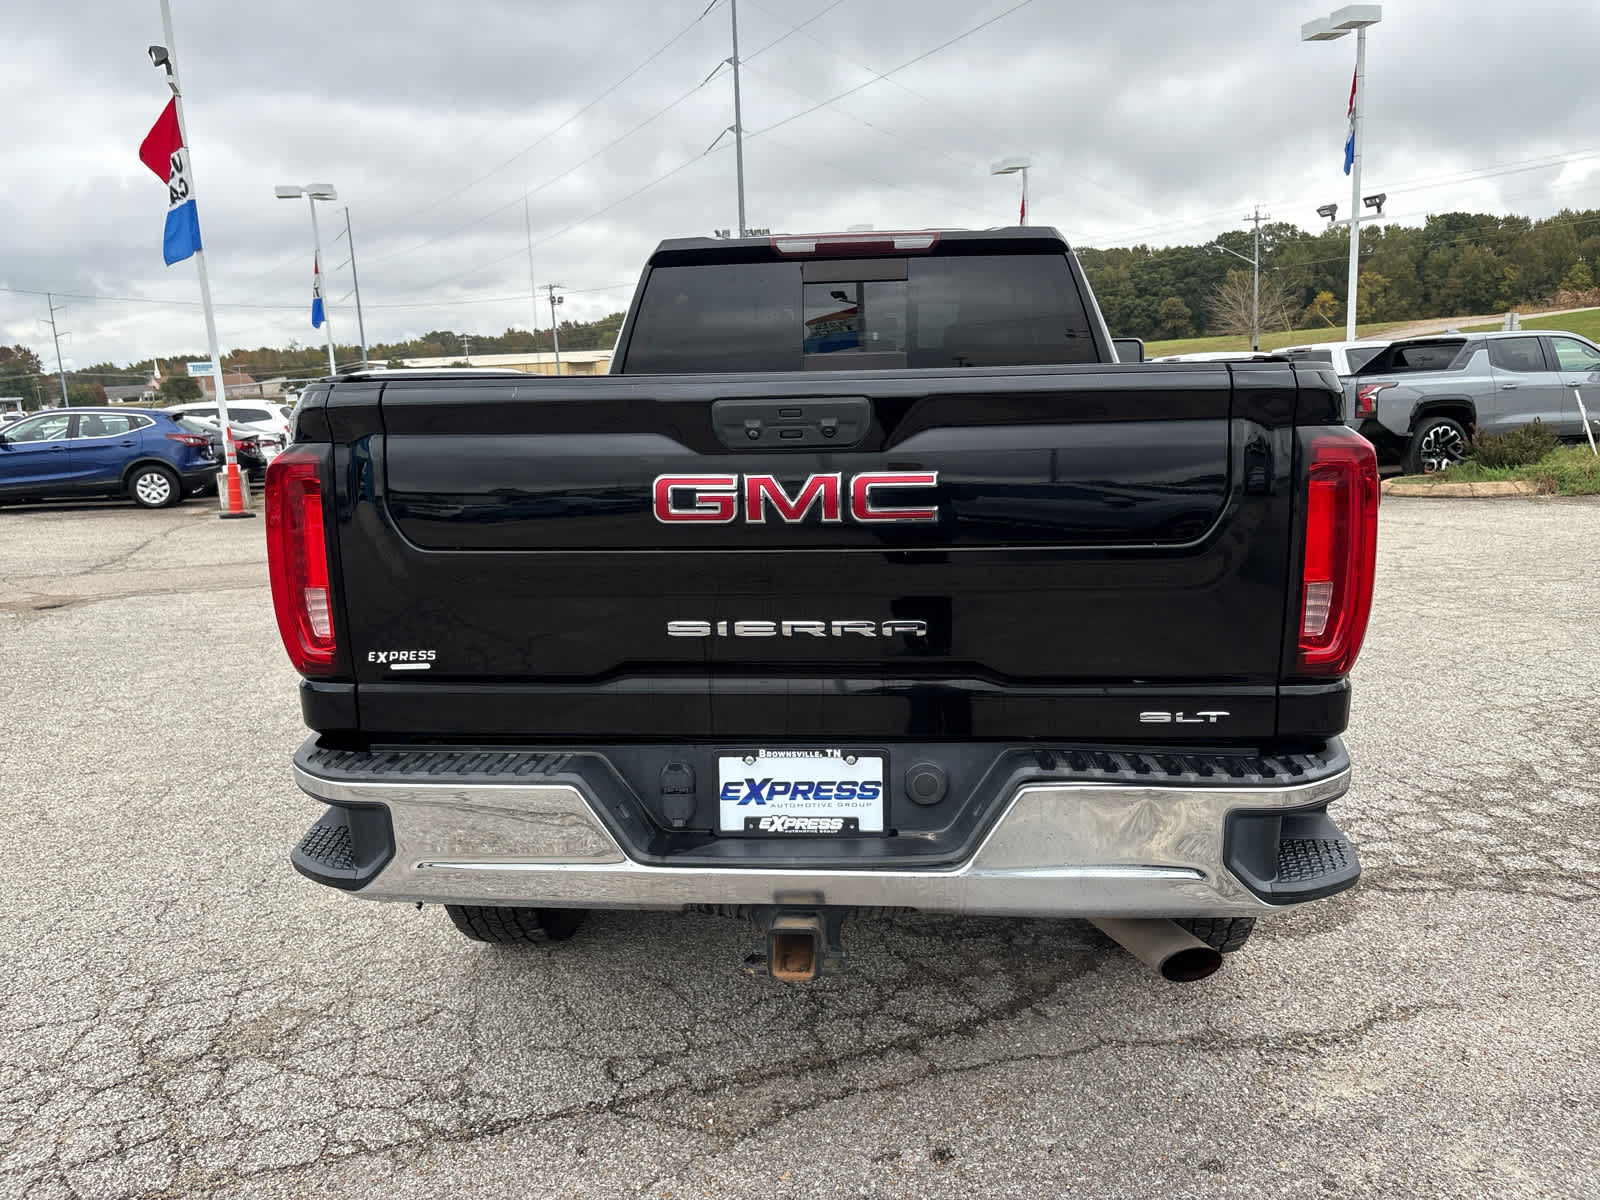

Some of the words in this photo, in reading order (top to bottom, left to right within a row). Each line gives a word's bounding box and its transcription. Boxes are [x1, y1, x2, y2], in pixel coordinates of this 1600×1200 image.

[653, 471, 939, 523] GMC
[667, 620, 927, 636] SIERRA
[367, 650, 437, 663] EXPRESS
[1139, 711, 1230, 722] SLT
[826, 749, 842, 758] TN
[720, 778, 882, 805] EXPRESS
[759, 815, 844, 831] EXPRESS
